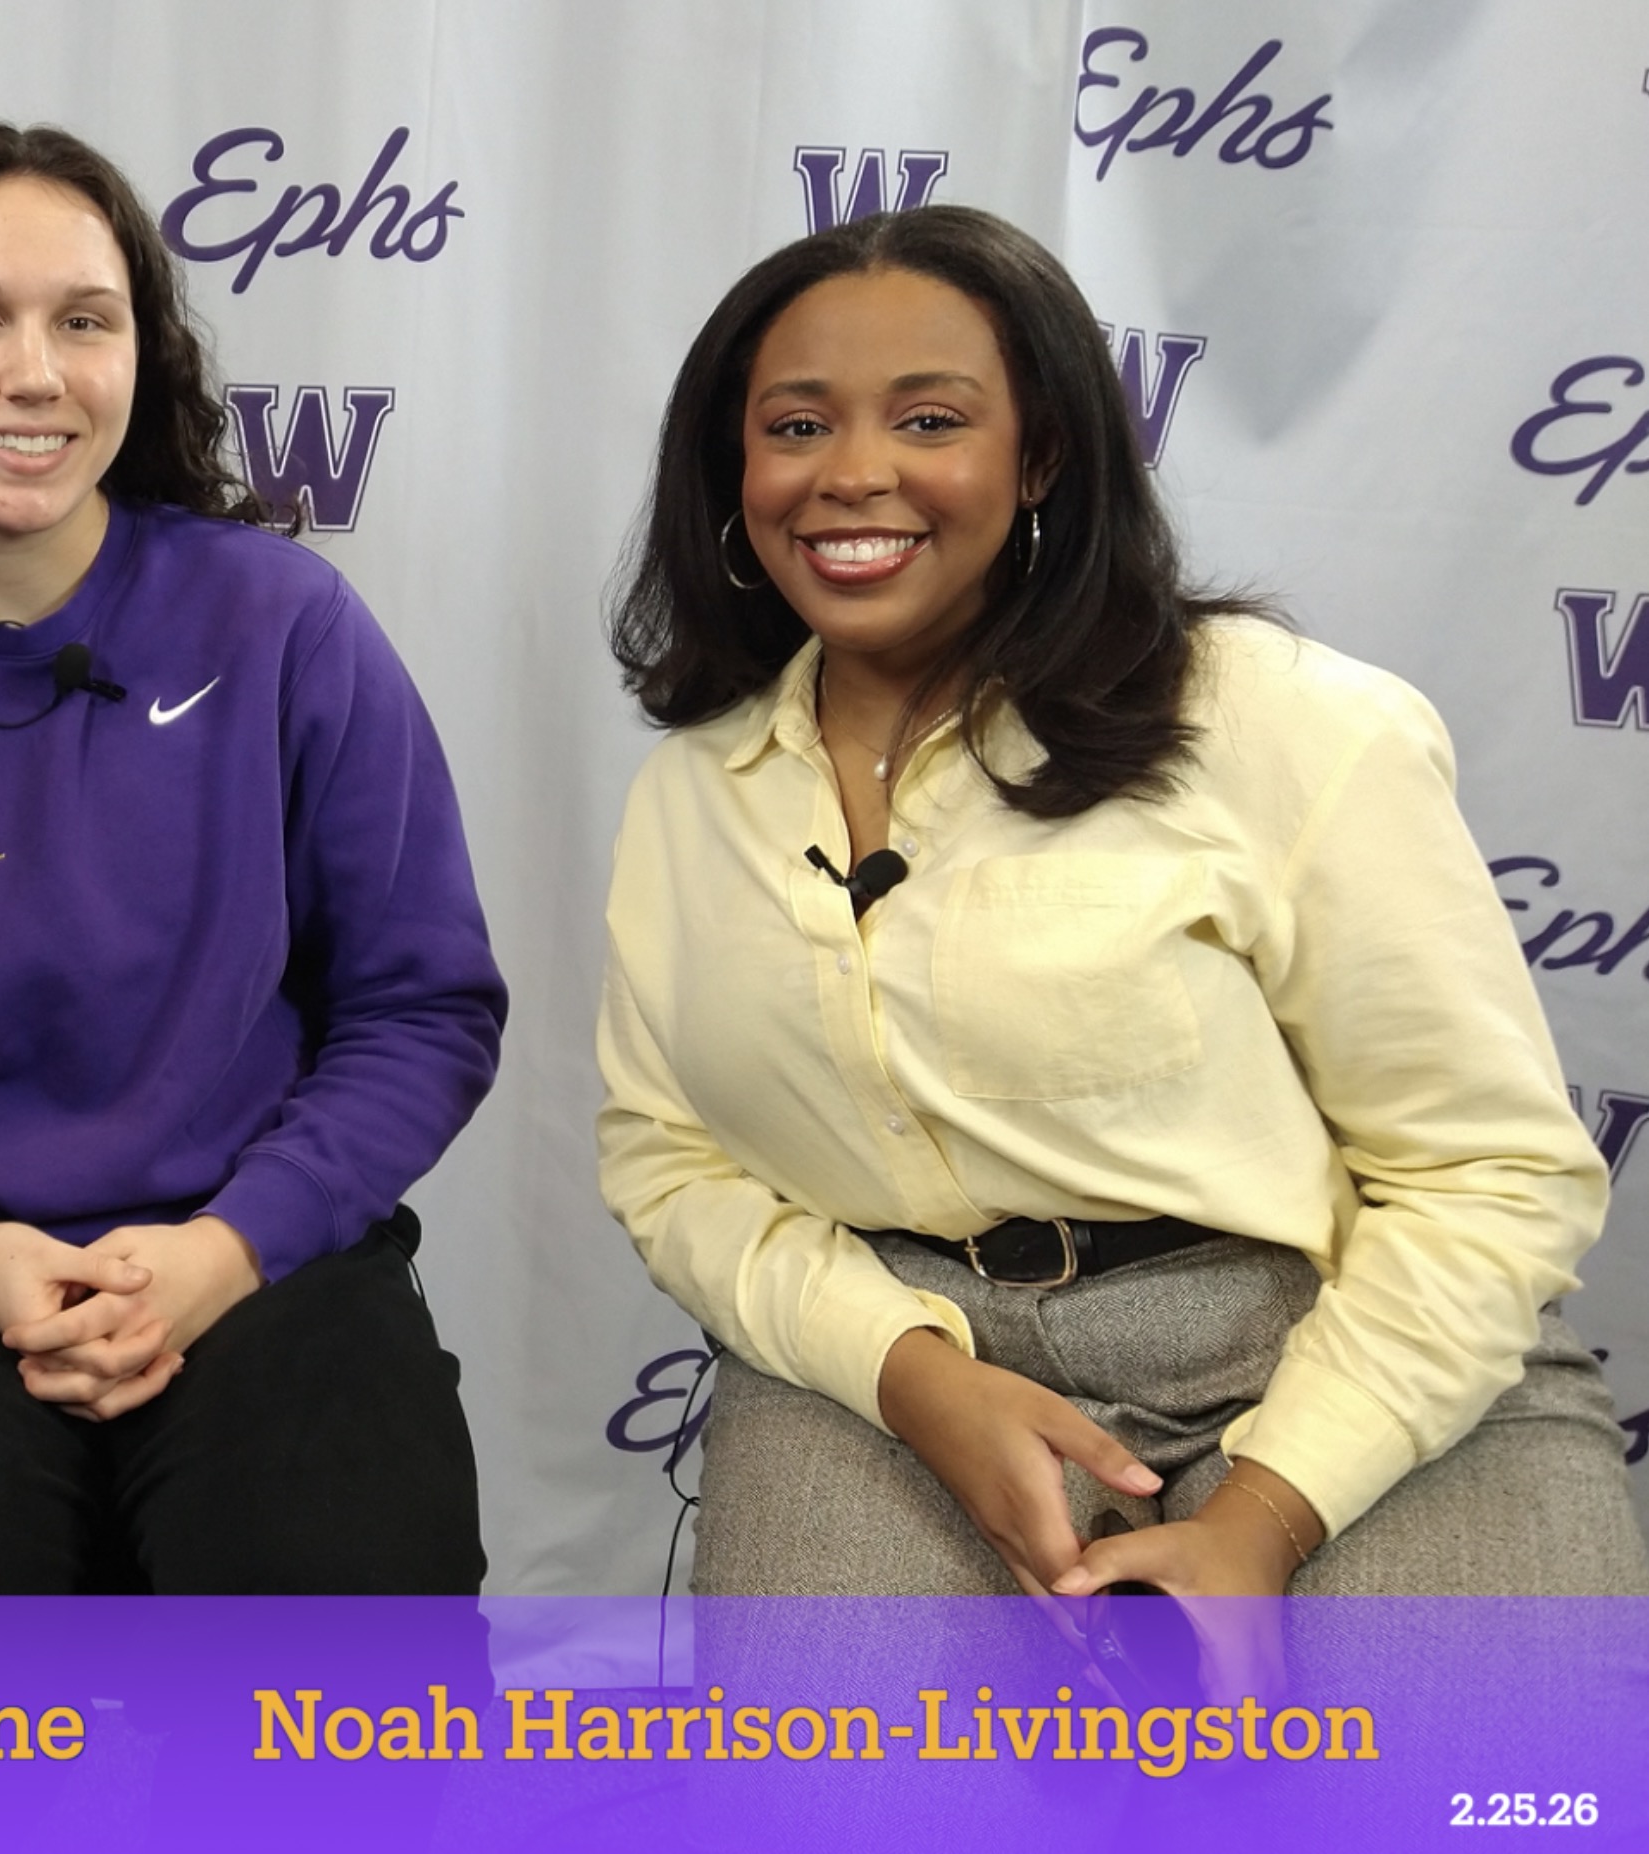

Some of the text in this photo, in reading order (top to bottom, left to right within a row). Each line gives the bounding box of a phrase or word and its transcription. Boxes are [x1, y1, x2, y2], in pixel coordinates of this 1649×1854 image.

[1074, 26, 1335, 182] Ephs
[162, 126, 465, 295] Ephs
[224, 384, 395, 533] W
